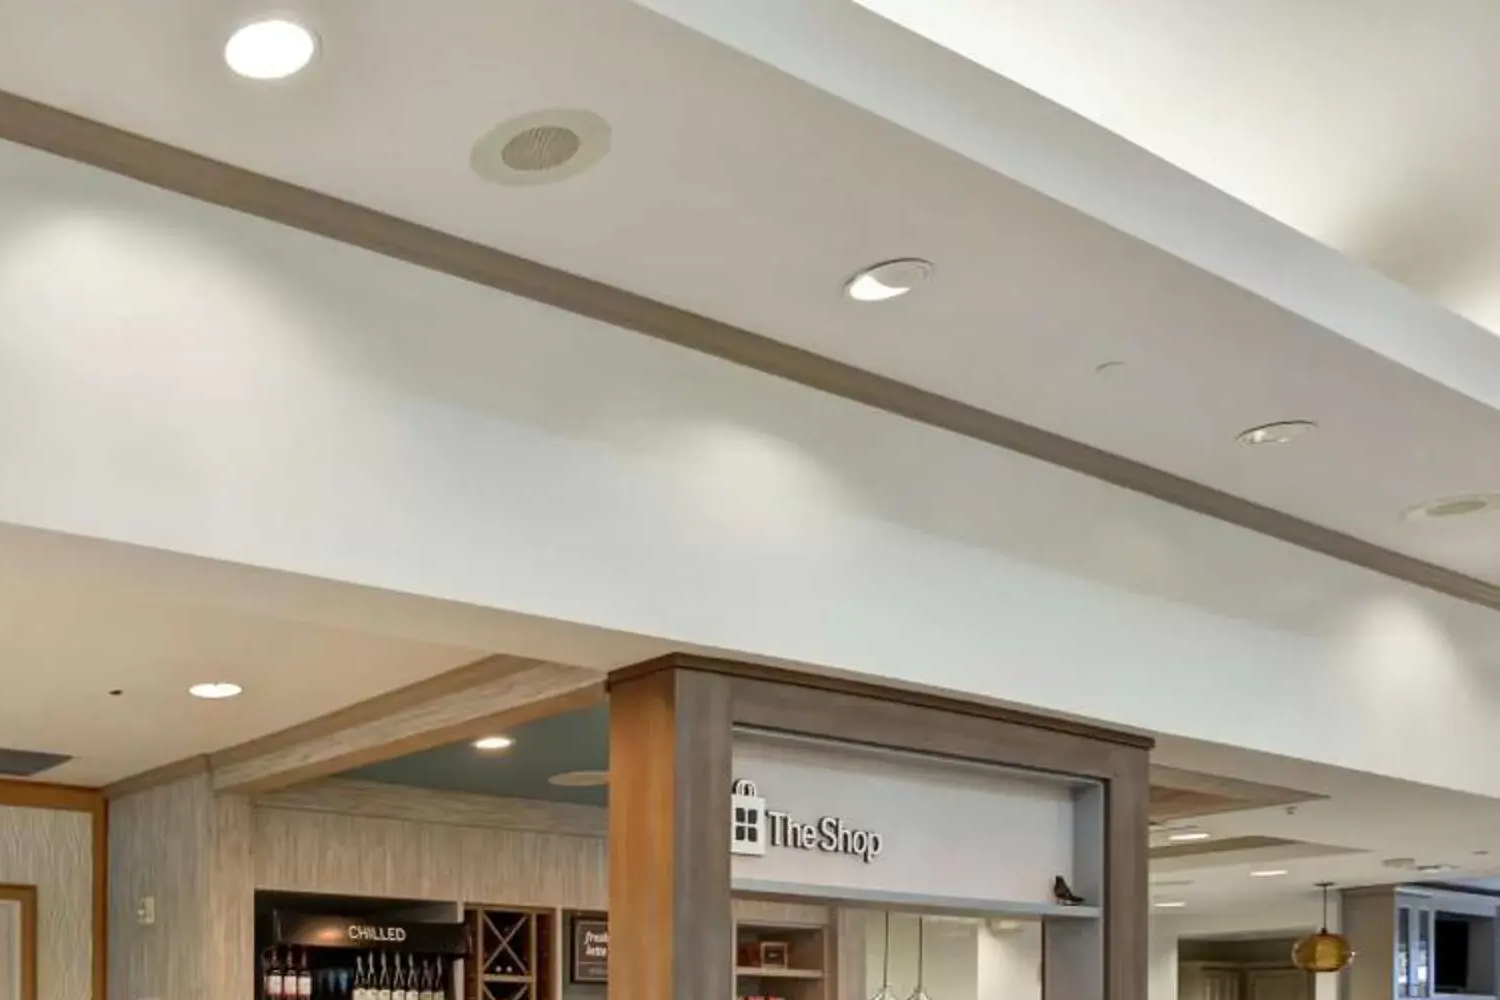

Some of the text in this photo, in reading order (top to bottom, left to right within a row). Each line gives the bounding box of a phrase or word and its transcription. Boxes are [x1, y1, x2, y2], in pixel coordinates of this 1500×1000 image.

[766, 810, 883, 862] The Shop
[349, 925, 407, 942] CHILLED
